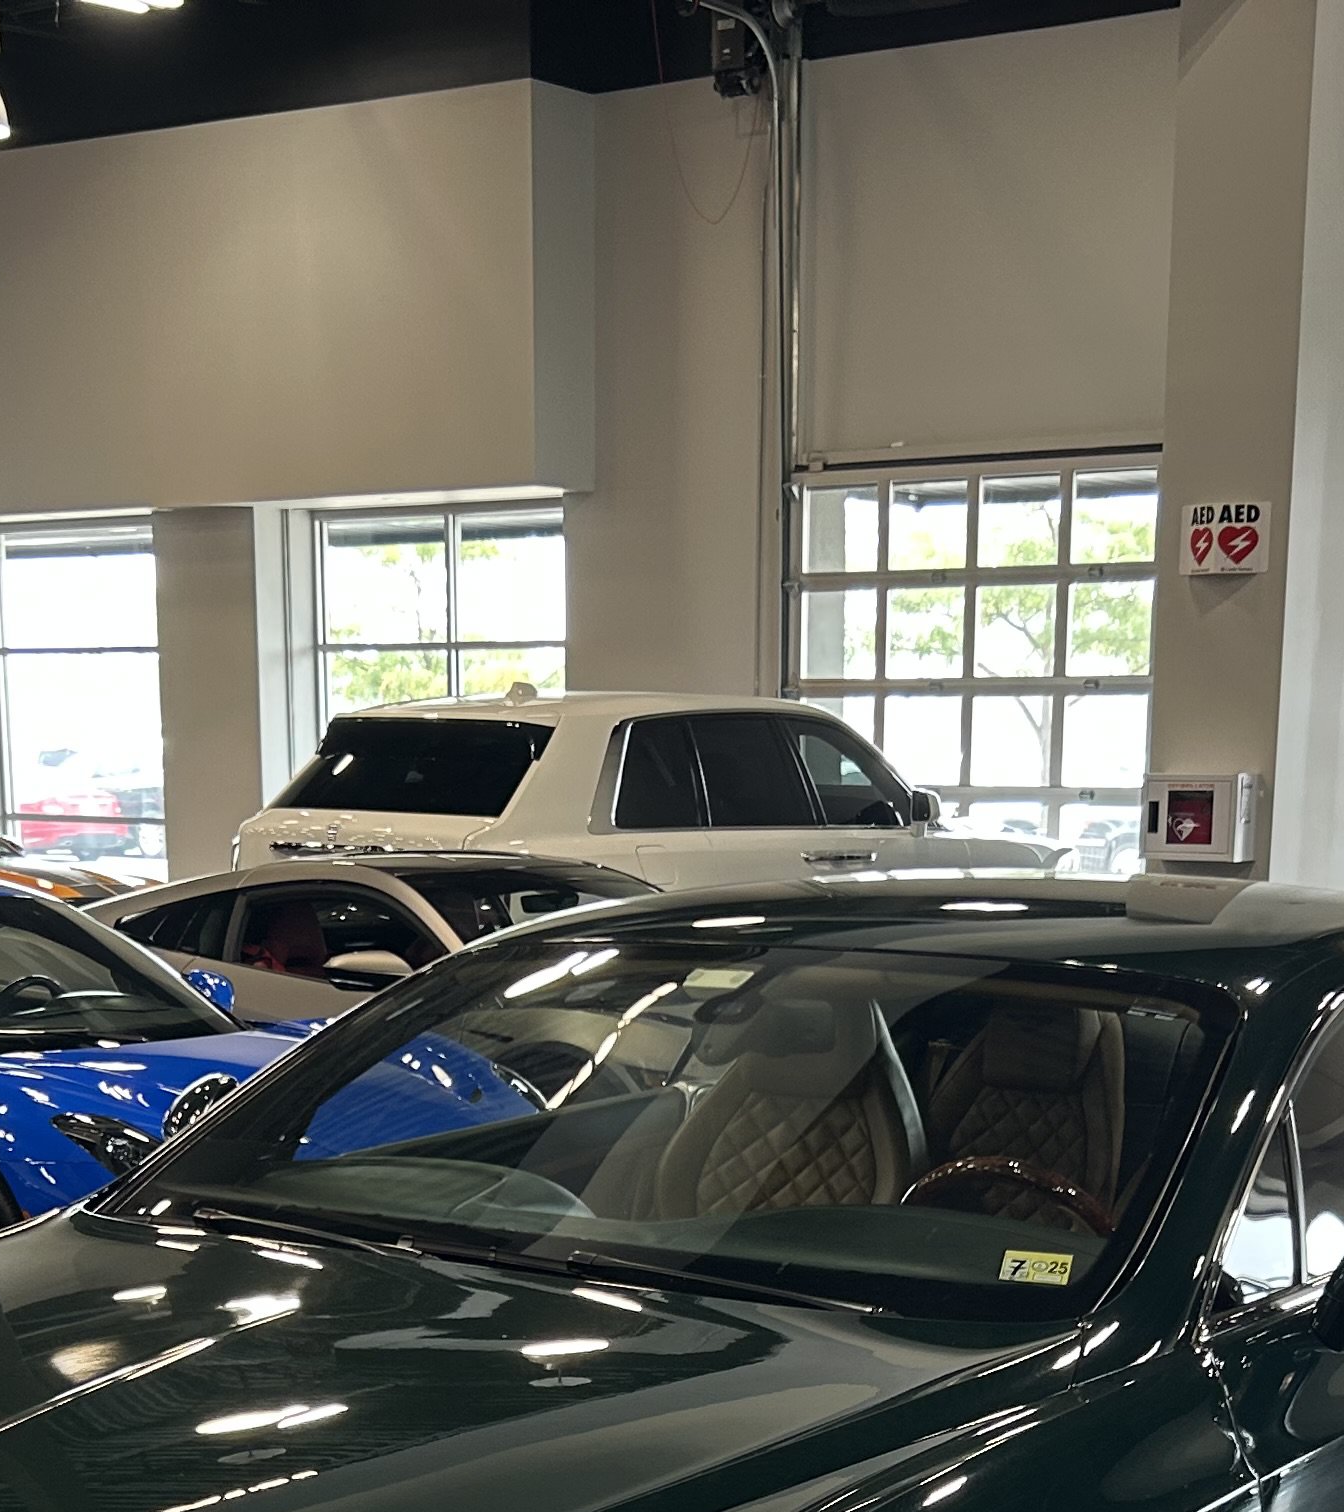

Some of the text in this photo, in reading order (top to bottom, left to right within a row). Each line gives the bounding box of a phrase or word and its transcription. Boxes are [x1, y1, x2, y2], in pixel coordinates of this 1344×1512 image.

[1191, 504, 1260, 526] AED AED
[1011, 1259, 1026, 1276] 7
[1048, 1261, 1068, 1275] 25
